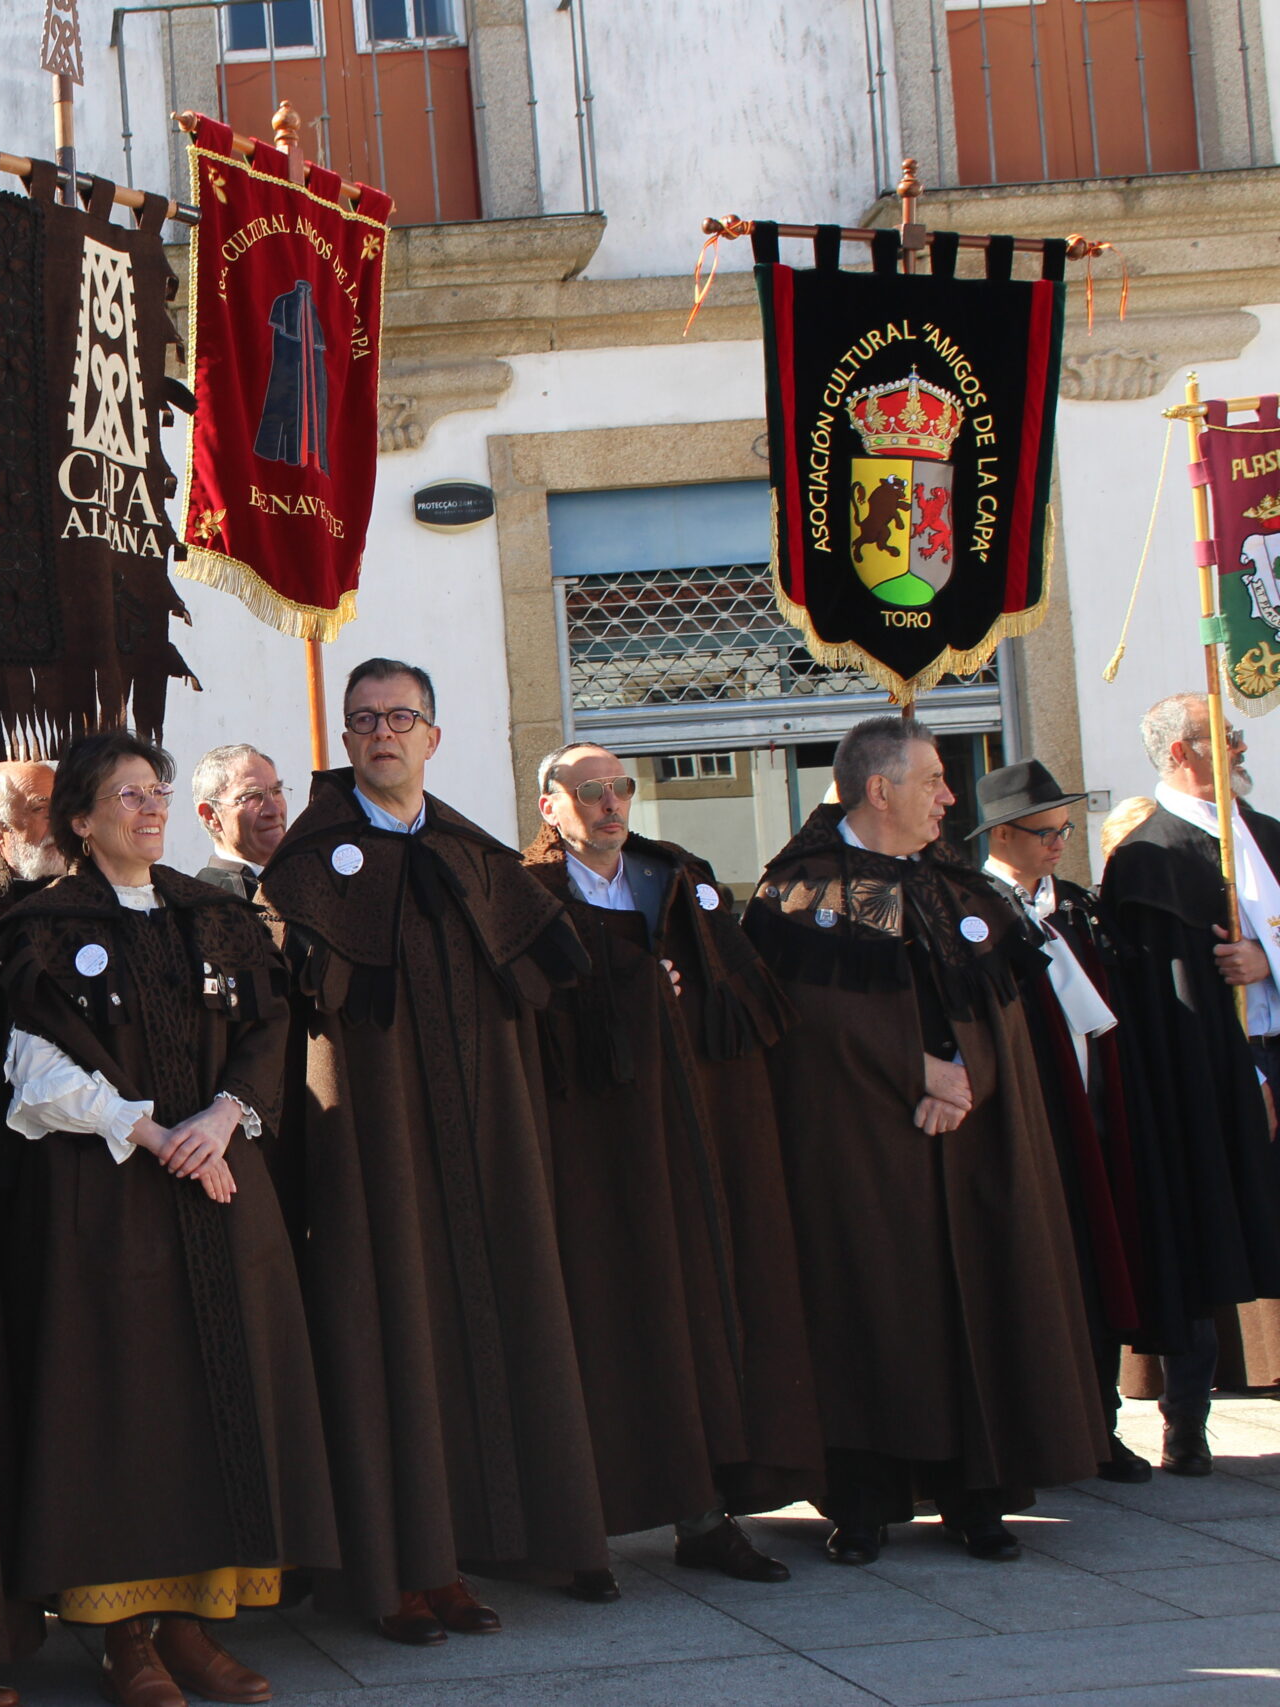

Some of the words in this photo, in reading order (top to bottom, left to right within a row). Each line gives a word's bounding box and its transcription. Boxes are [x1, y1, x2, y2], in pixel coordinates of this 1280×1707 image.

[221, 213, 290, 262] CULTURAL
[294, 214, 333, 260] AMIGOS
[332, 254, 348, 285] DE
[823, 318, 917, 409] CULTURAL
[972, 414, 996, 448] DE
[58, 450, 163, 527] CAPA
[808, 410, 835, 553] ASOCIACIÓN
[976, 456, 999, 489] LA
[879, 610, 932, 629] TORO
